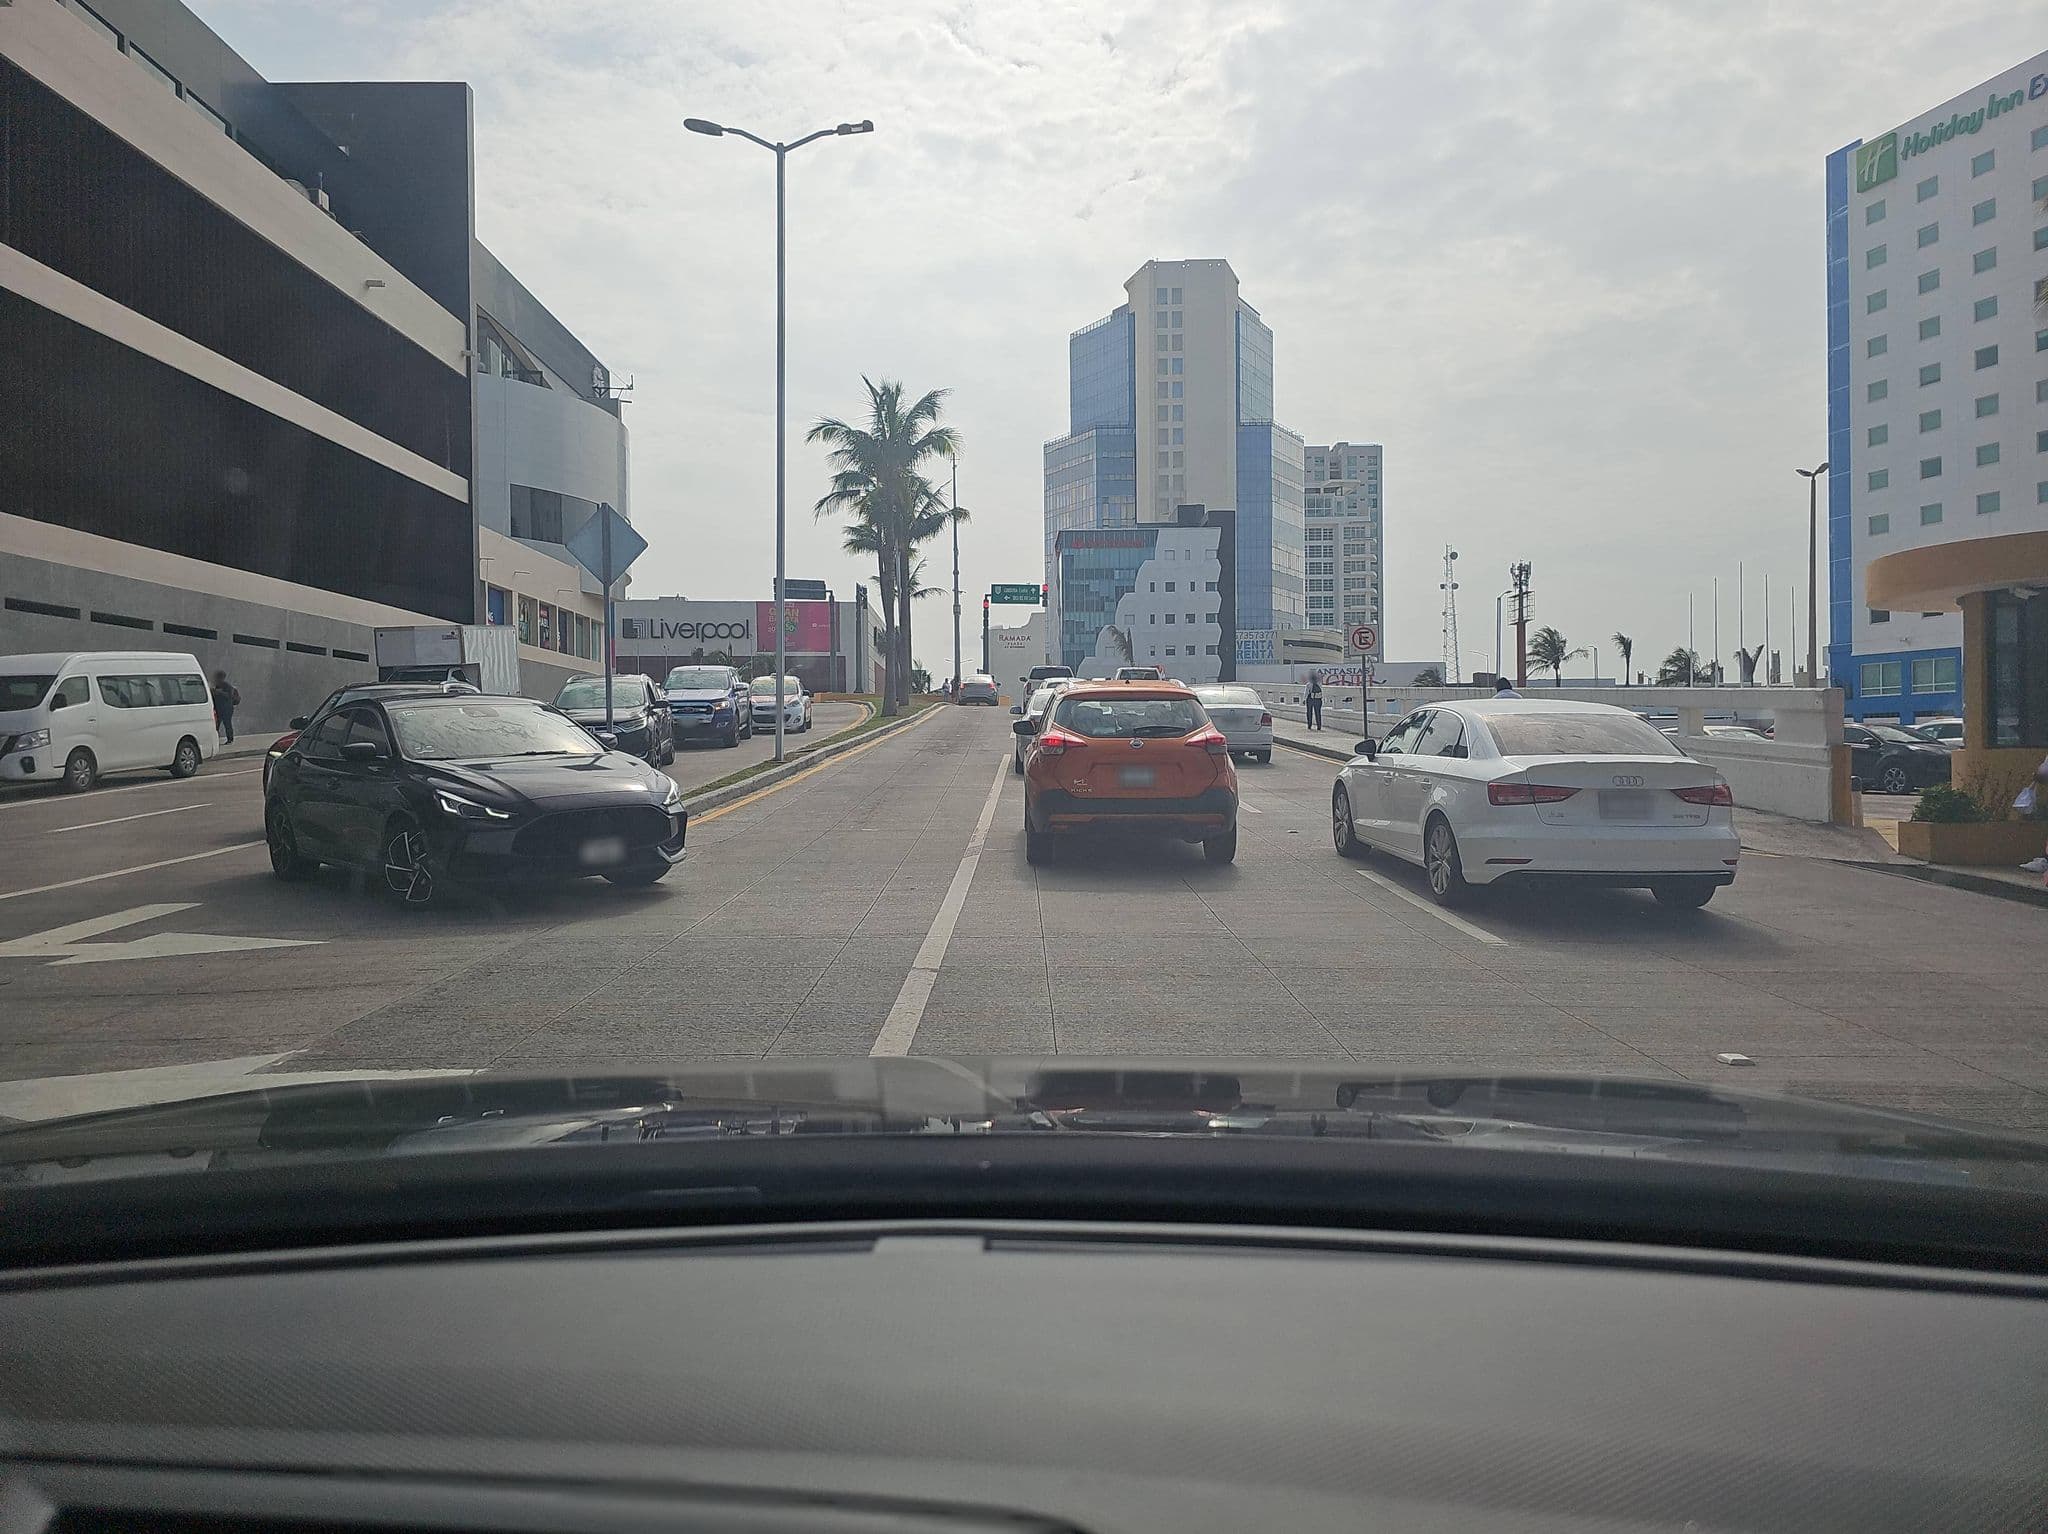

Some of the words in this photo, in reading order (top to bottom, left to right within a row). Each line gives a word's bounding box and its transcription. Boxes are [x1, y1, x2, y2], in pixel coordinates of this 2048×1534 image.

[1901, 107, 1984, 160] Holiday
[1986, 88, 2024, 120] Inn
[650, 618, 750, 643] Liverpool
[1236, 640, 1274, 650] VENTA
[1236, 650, 1274, 659] RENTA
[1310, 667, 1370, 675] ANTASIAS
